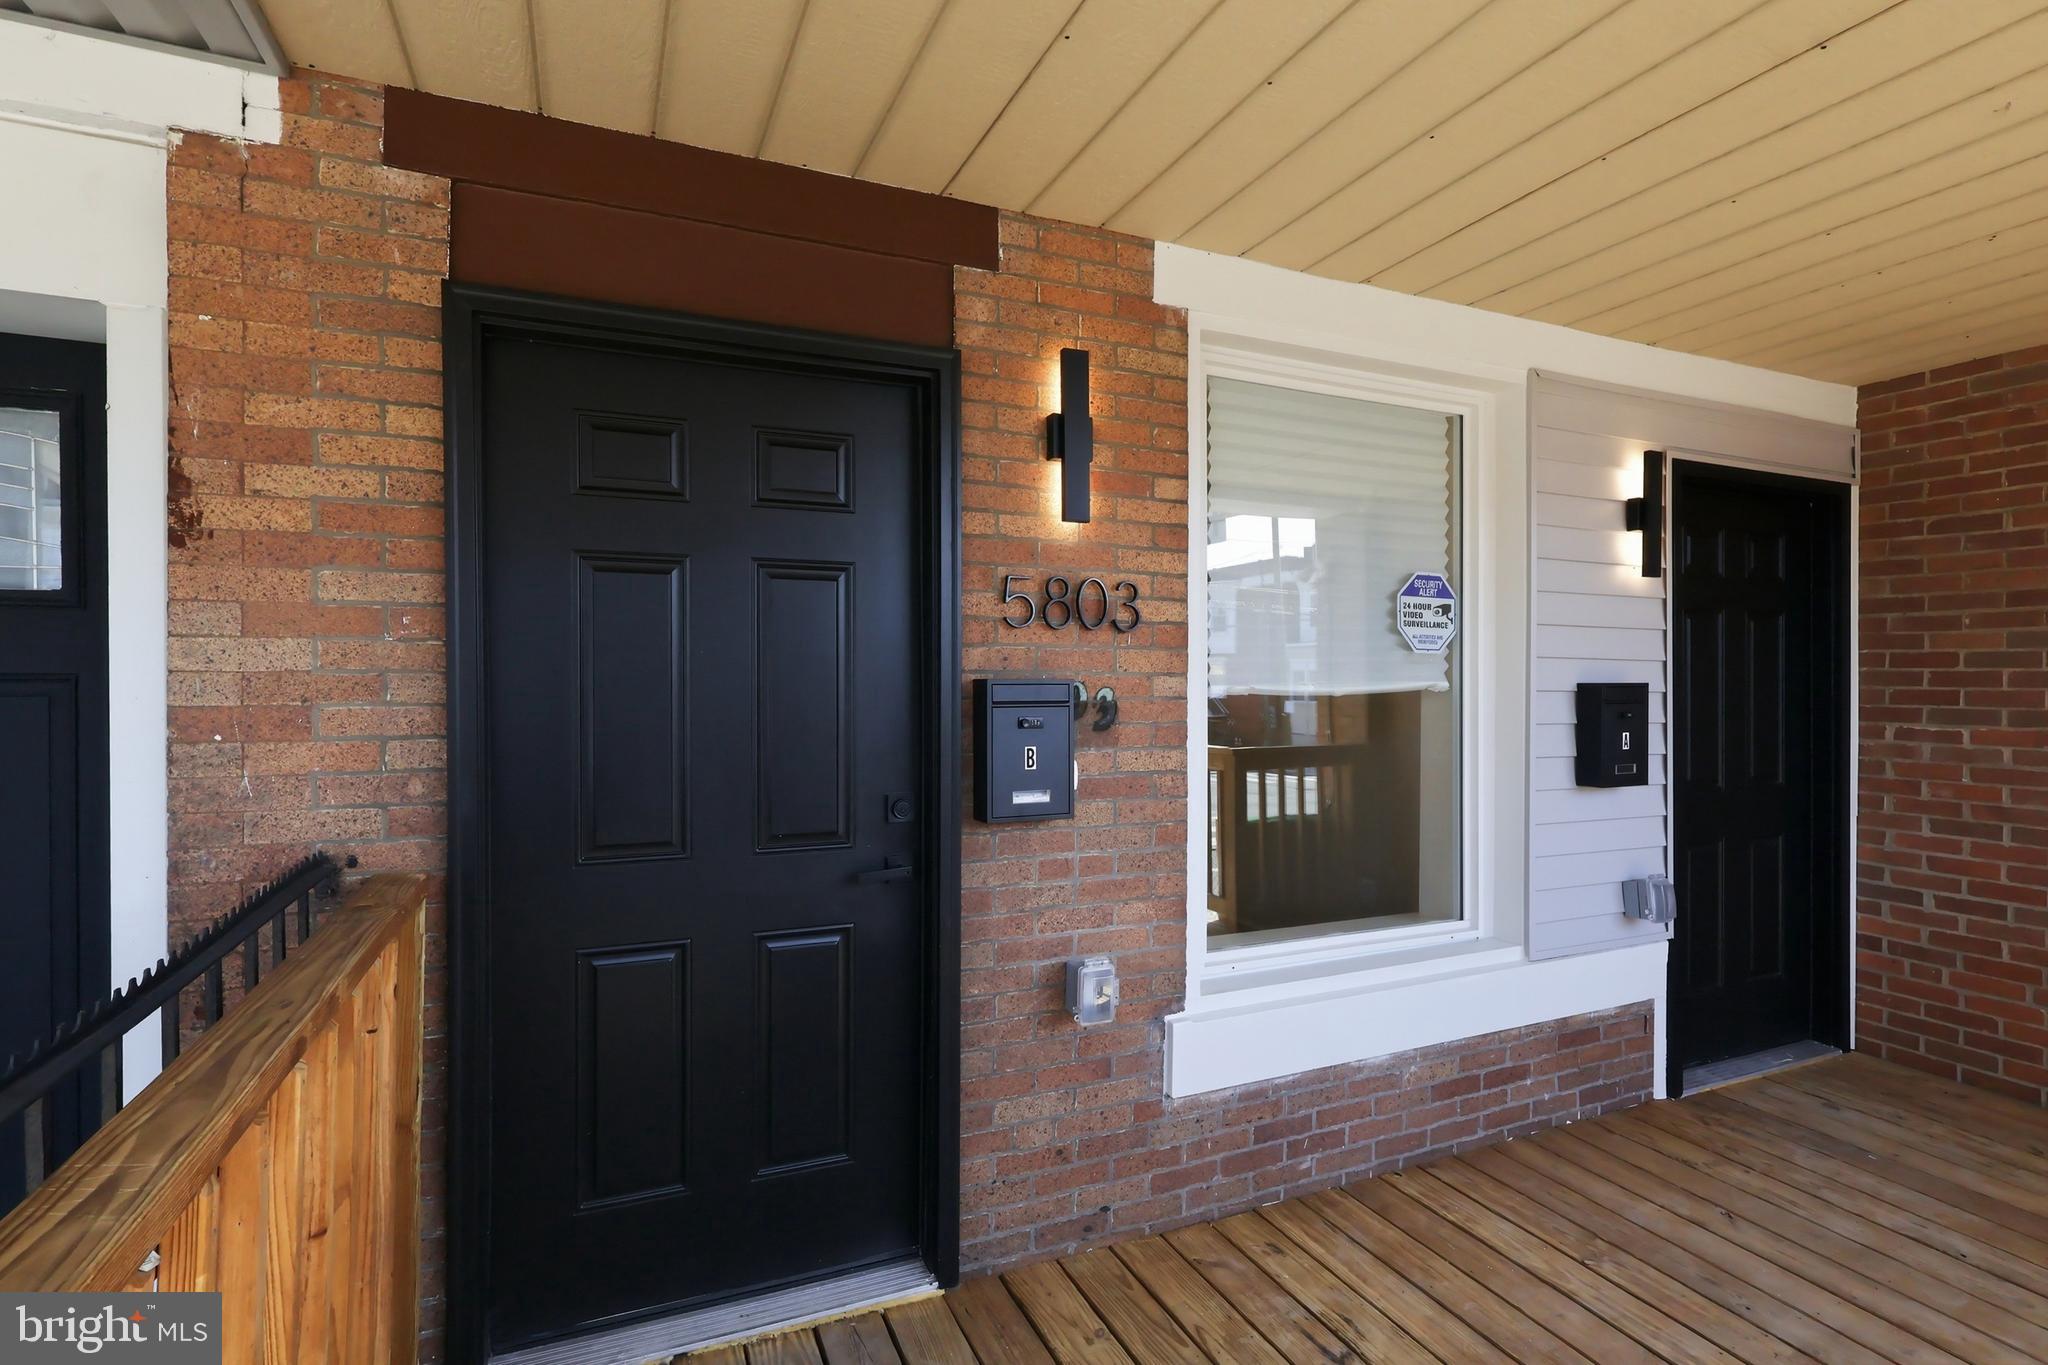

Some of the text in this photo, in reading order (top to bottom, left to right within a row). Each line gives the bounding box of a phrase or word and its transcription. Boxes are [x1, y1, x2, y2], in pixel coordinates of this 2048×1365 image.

[1414, 580, 1442, 589] SECURITY
[1419, 588, 1437, 597] ALERT
[1003, 575, 1140, 633] 5803
[1403, 611, 1423, 619] VIDEO
[1403, 620, 1448, 629] SURVEILLANCE
[1623, 733, 1629, 749] A
[1026, 747, 1035, 768] B
